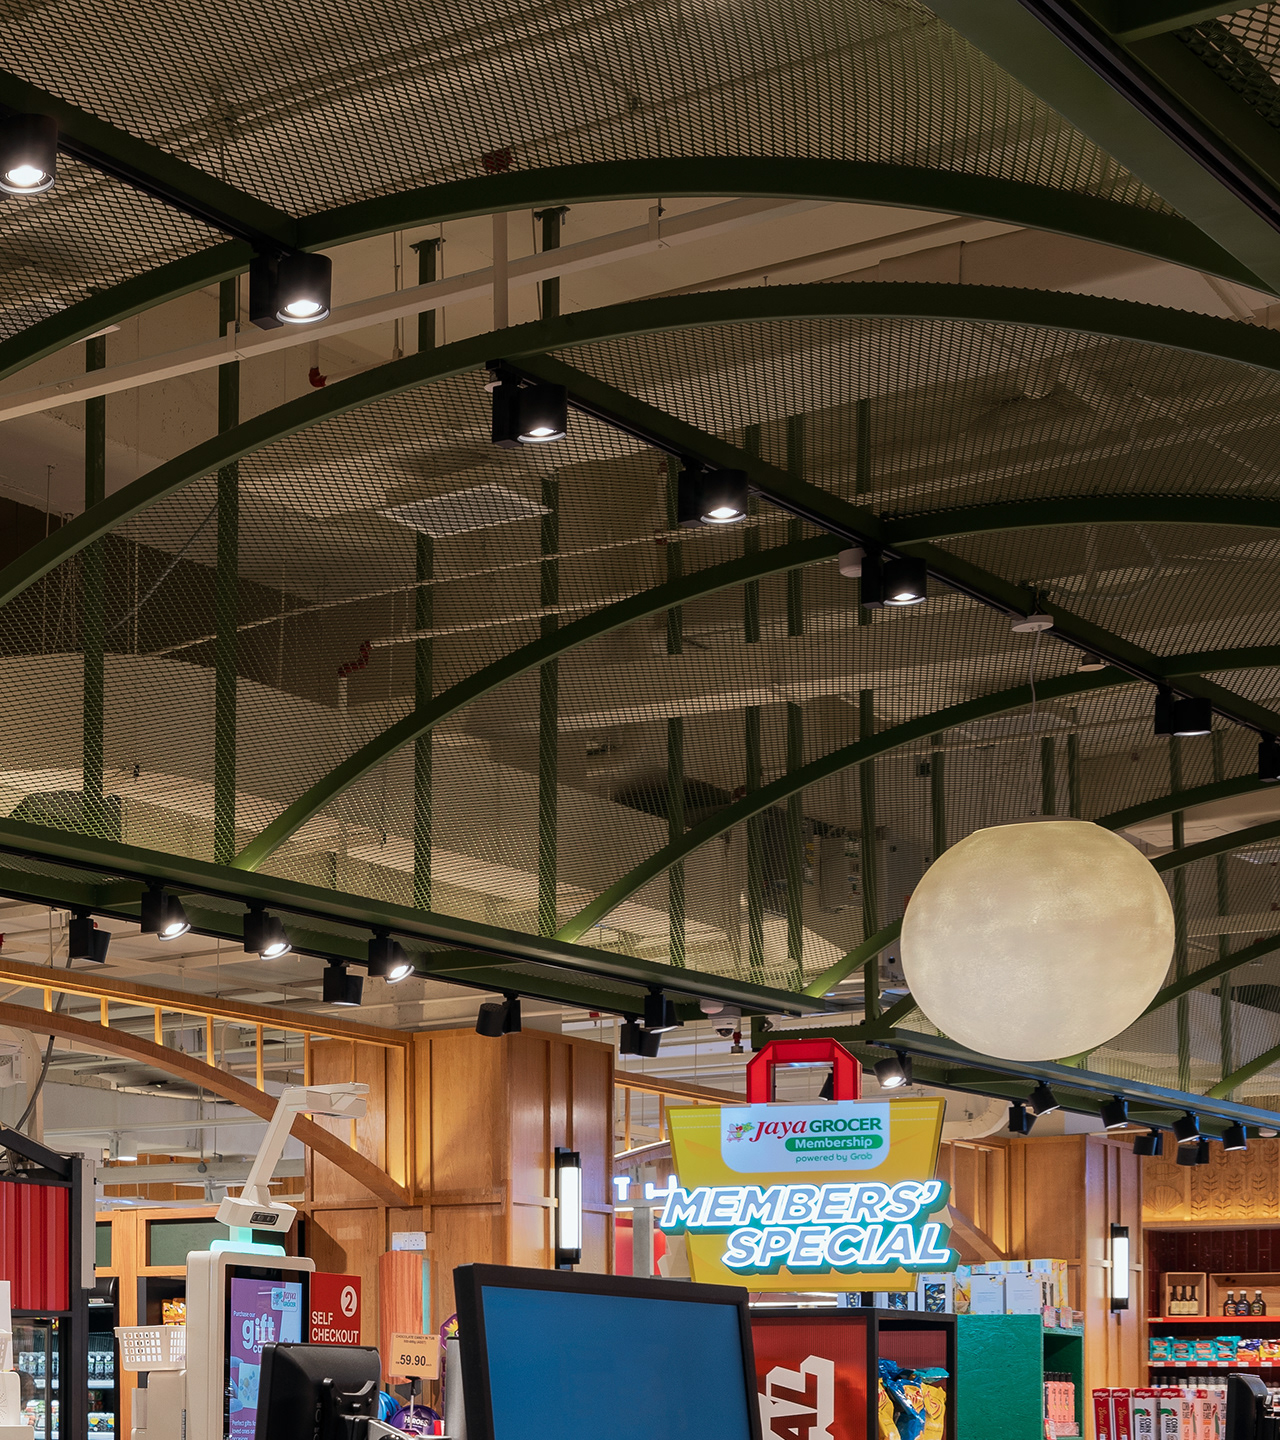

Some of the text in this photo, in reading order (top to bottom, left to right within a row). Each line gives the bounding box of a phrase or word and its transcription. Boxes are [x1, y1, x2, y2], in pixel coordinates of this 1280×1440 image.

[750, 1118, 882, 1142] Jaya GROCER
[795, 1136, 872, 1149] Membership
[796, 1152, 872, 1164] powered by Grab
[722, 1223, 953, 1266] SPECIAL
[345, 1291, 353, 1312] 2
[312, 1311, 333, 1325] SELF
[312, 1329, 358, 1343] CHECKOUT
[400, 1355, 426, 1366] 59.90
